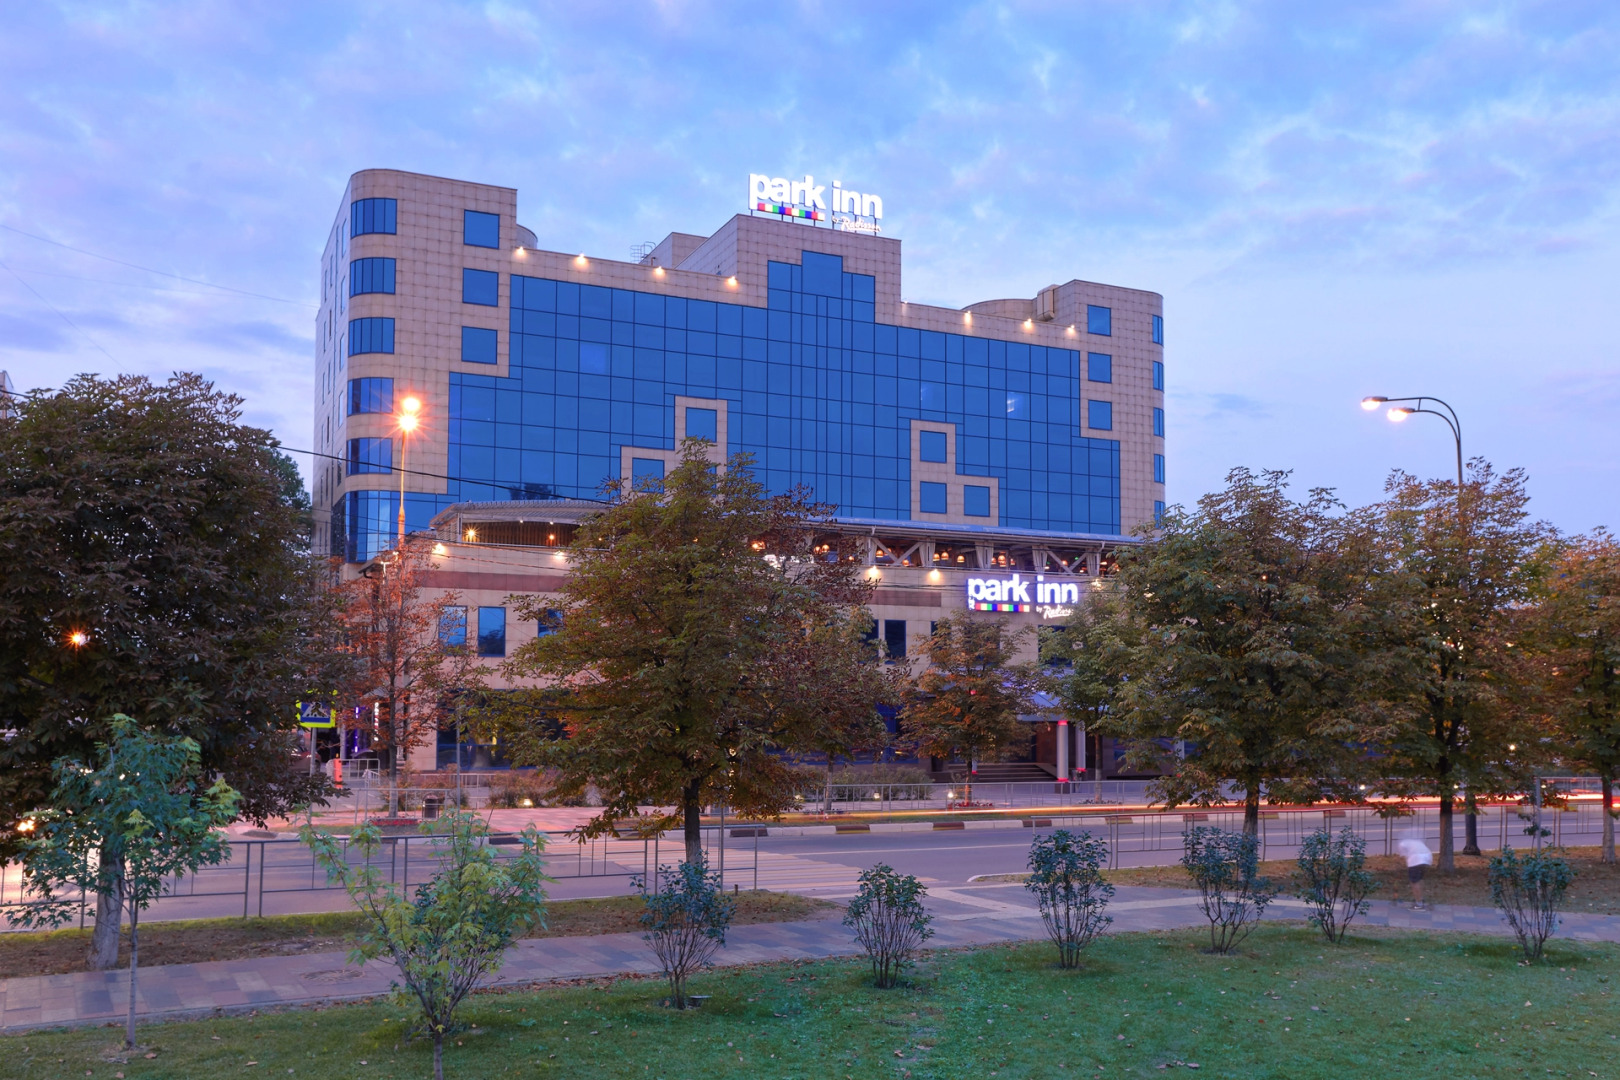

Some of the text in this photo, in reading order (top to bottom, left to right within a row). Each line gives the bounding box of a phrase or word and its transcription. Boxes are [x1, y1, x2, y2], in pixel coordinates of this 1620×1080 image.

[749, 173, 882, 219] park inn
[841, 215, 881, 232] Radisson
[967, 573, 1078, 610] park inn
